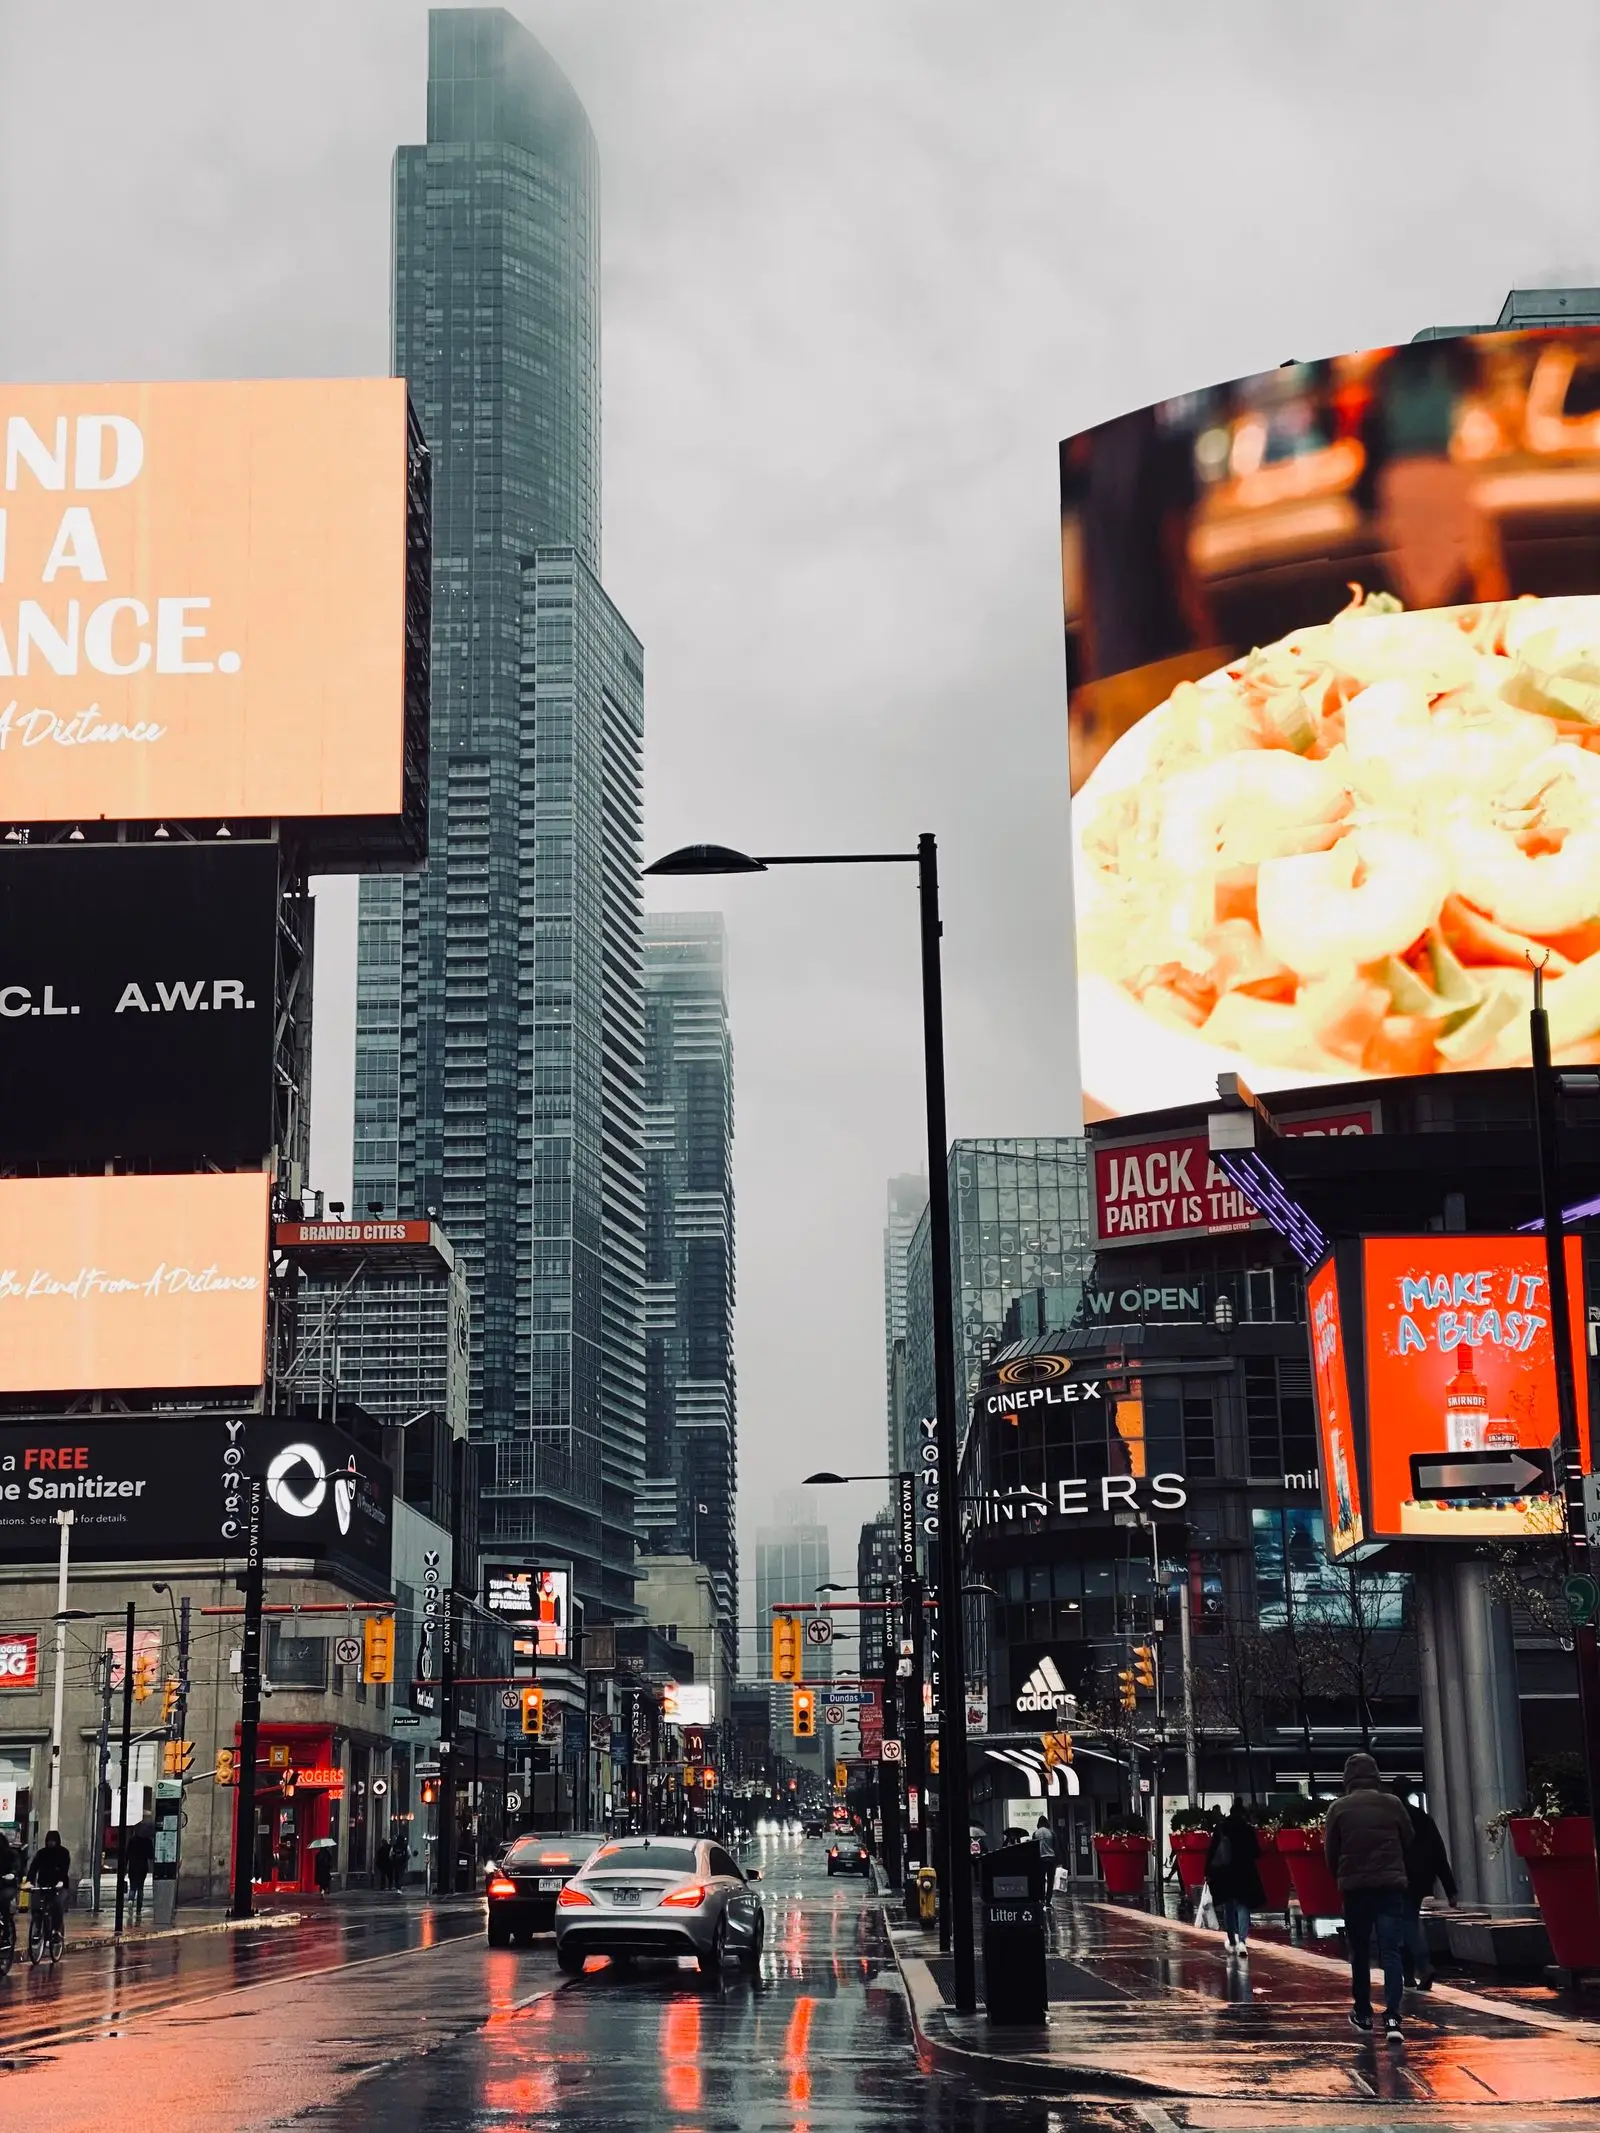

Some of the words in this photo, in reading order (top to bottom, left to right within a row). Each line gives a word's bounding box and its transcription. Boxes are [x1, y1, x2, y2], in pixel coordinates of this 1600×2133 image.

[5, 415, 144, 491] ND
[42, 507, 107, 582] A
[16, 702, 168, 748] Distance
[0, 986, 80, 1017] C.L.
[114, 980, 256, 1013] A.W.R.
[1105, 1149, 1195, 1203] JACK
[1106, 1200, 1176, 1233] PARTY
[1182, 1197, 1203, 1224] IS
[1208, 1224, 1232, 1233] BRANDED
[1232, 1222, 1250, 1231] CITIES
[300, 1226, 361, 1242] BRANDED
[364, 1224, 406, 1240] CITIES
[25, 1268, 86, 1300] Kind
[81, 1267, 140, 1298] From
[164, 1263, 260, 1293] Distance
[1402, 1271, 1492, 1312] MAKE
[1507, 1272, 1544, 1309] IT
[1120, 1287, 1200, 1313] OPEN
[1399, 1314, 1428, 1355] A
[1437, 1309, 1547, 1353] BLAST
[987, 1381, 1101, 1414] CINEPLEX
[1447, 1395, 1486, 1407] SMIRNOFF
[2, 1455, 16, 1471] a
[24, 1447, 89, 1470] FREE
[27, 1475, 146, 1500] Sanitizer
[30, 1516, 47, 1525] See
[81, 1514, 93, 1523] for
[96, 1514, 128, 1523] details.
[250, 1481, 260, 1567] DOWNTOWN
[904, 1479, 912, 1562] DOWNTOWN
[443, 1593, 451, 1653] DOWNTOWN
[829, 1694, 859, 1702] Dundas
[1016, 1690, 1078, 1712] adidas
[297, 1768, 344, 1783] ROGERS
[990, 1908, 1018, 1922] Litter
